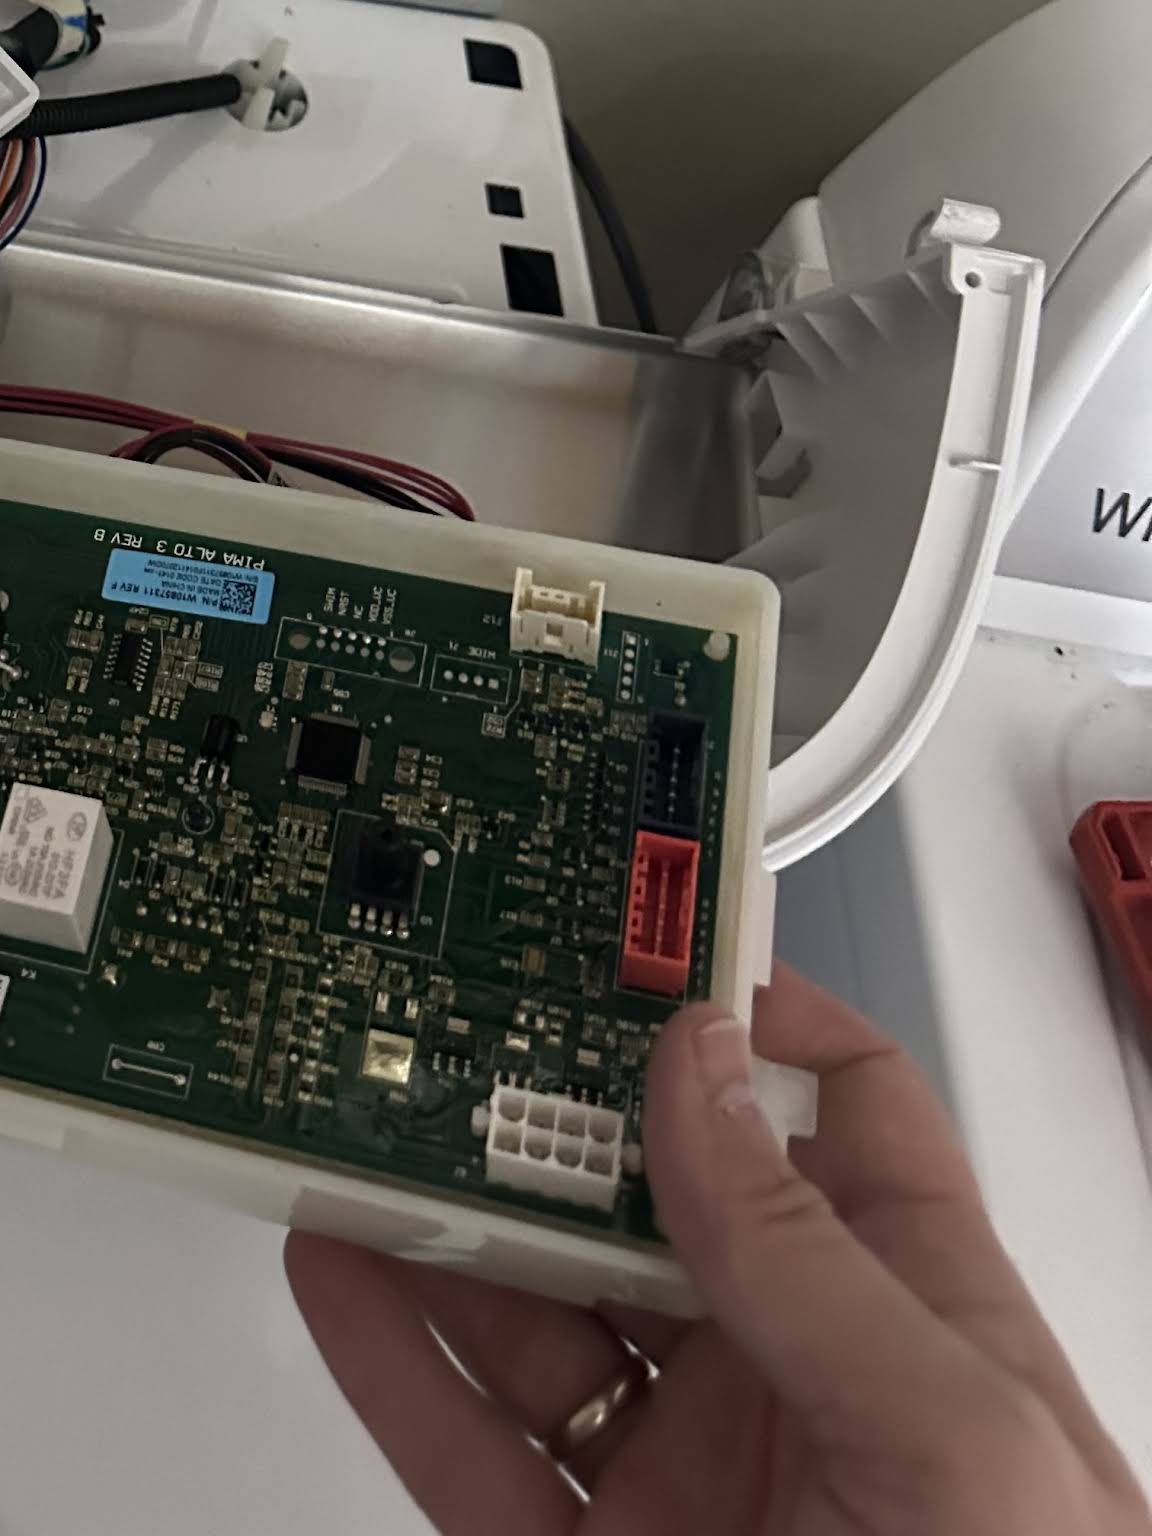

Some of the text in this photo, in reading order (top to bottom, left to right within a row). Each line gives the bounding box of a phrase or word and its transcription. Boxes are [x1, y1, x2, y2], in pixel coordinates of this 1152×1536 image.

[1092, 486, 1152, 542] W
[93, 528, 265, 569] PIMA ALTO 3 REV B
[176, 572, 199, 582] CODE
[201, 576, 222, 586] DATE
[121, 582, 139, 592] REV
[143, 586, 197, 601] W10857311
[161, 580, 220, 596] MADE IN CHINA
[201, 596, 218, 607] P/N
